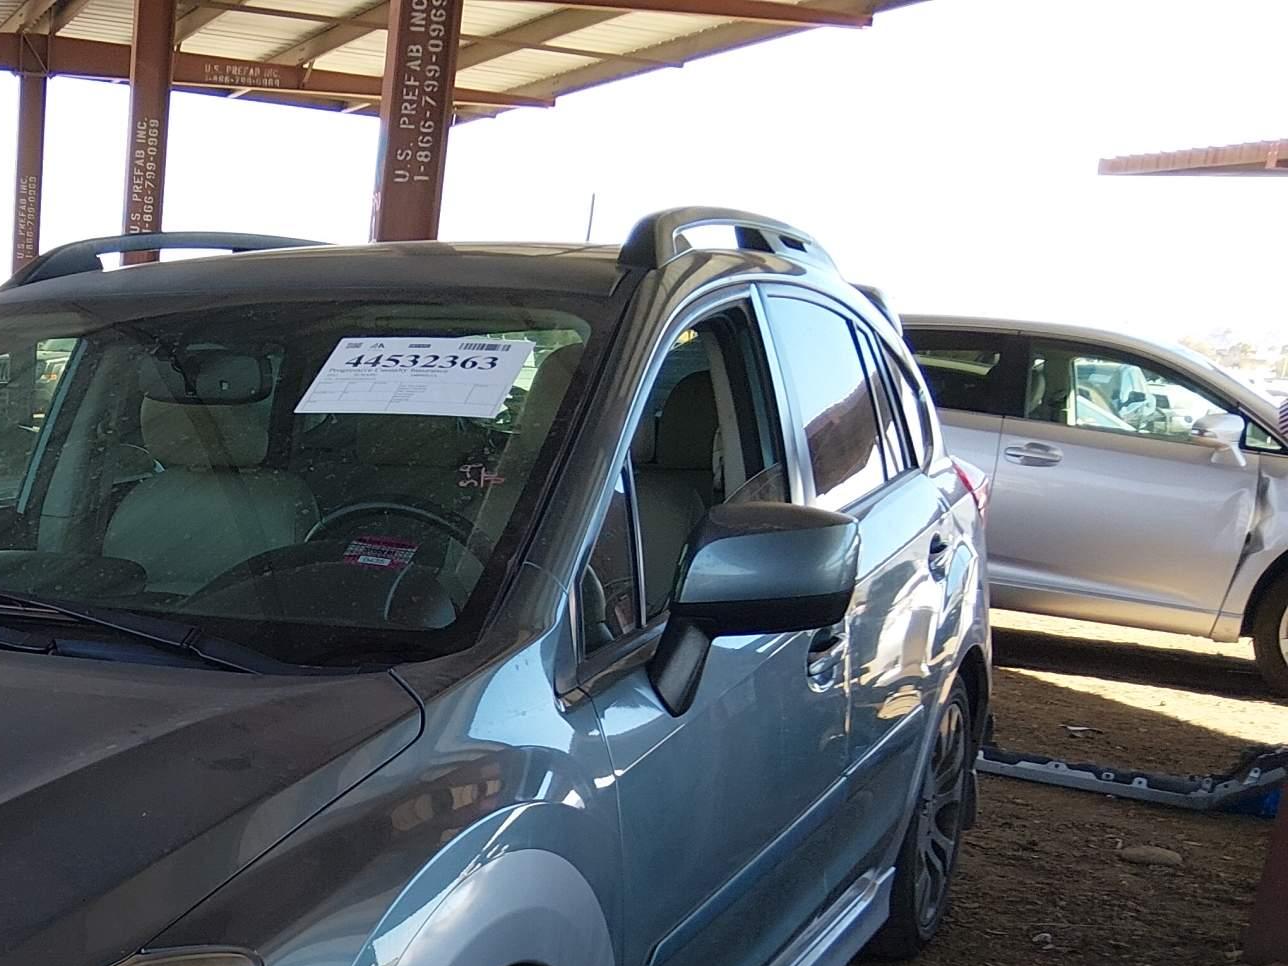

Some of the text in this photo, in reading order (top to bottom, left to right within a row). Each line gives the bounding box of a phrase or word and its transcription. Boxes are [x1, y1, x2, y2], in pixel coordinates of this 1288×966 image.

[400, 45, 423, 128] PREFAB
[137, 117, 148, 143] INC.
[132, 150, 145, 202] PREFAB
[394, 143, 414, 182] U.S.
[18, 198, 28, 236] PREFAB
[345, 354, 499, 370] 44532363
